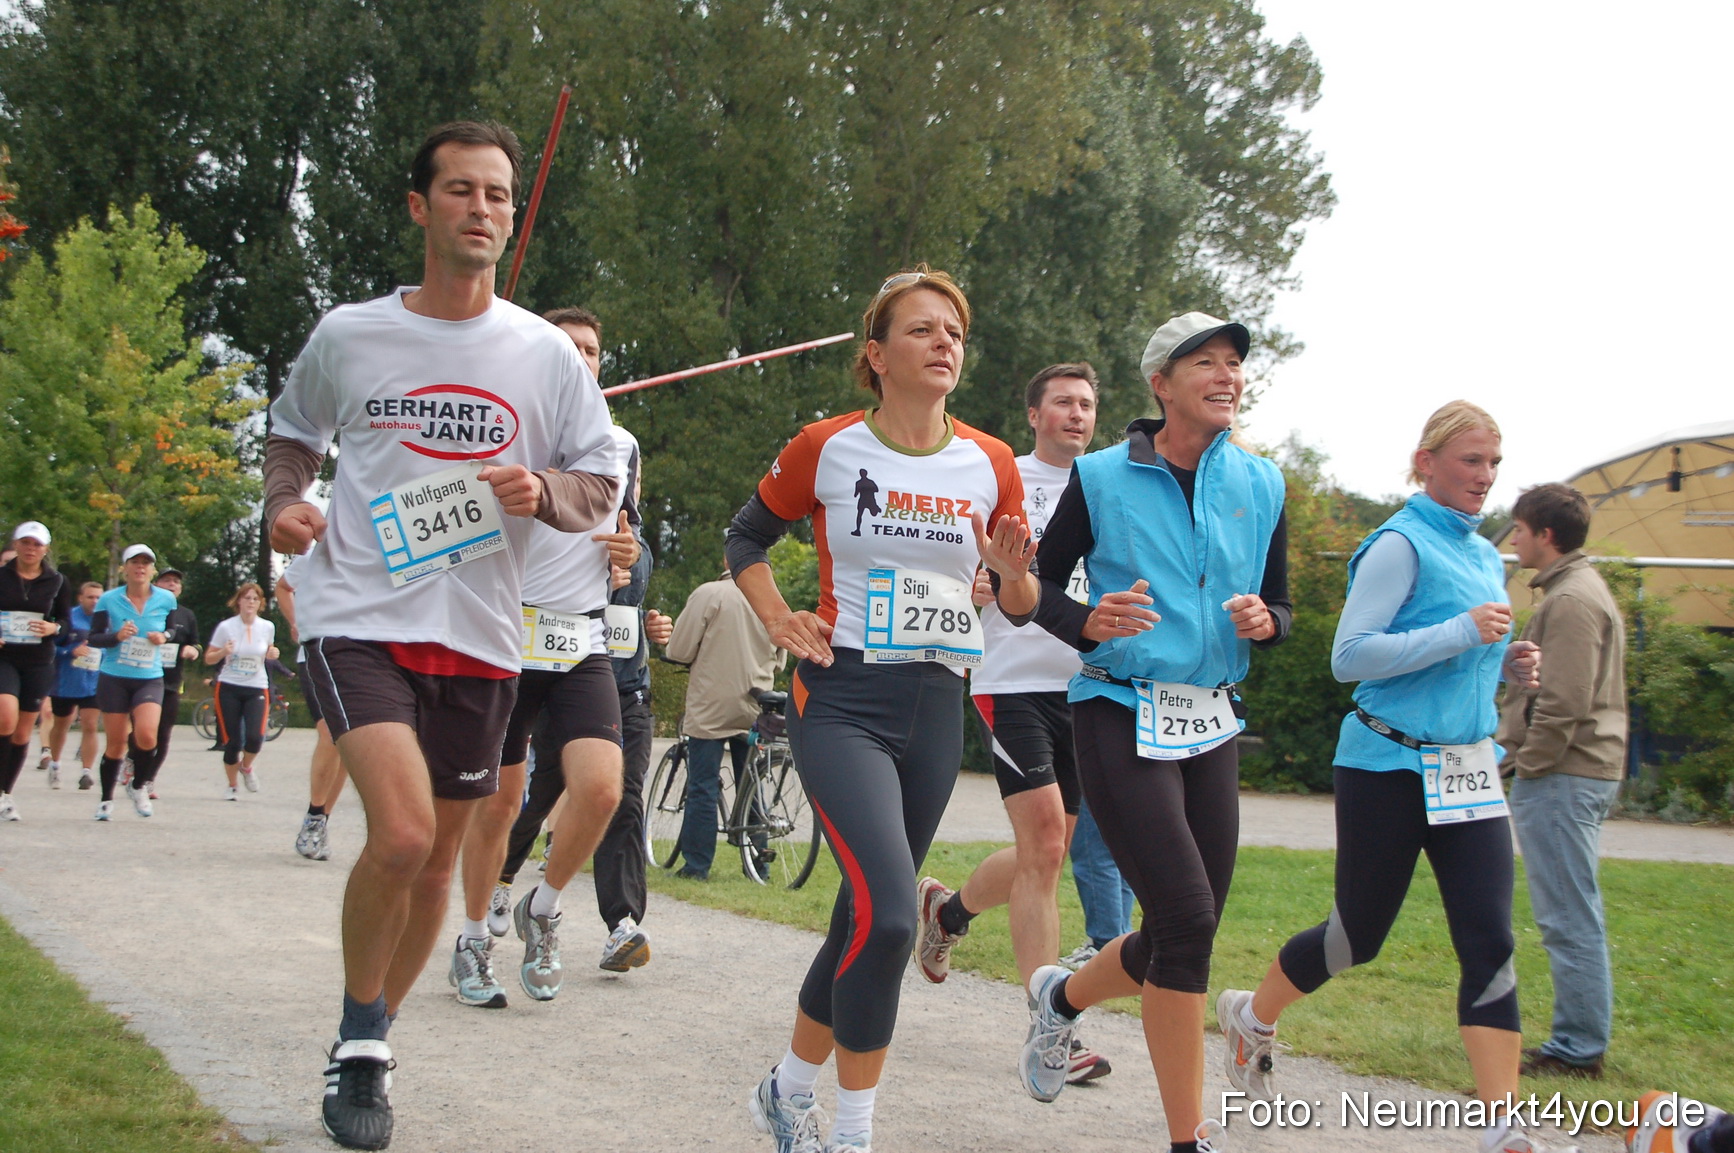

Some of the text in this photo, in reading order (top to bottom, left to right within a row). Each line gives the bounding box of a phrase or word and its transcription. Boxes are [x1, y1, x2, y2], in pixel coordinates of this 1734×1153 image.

[366, 399, 504, 424] GERHART &
[370, 420, 422, 431] Autohaus
[421, 421, 505, 444] JÄNIG
[400, 479, 467, 509] Wolfgang
[887, 490, 974, 519] MERZ
[413, 499, 483, 542] 3416
[882, 503, 956, 527] Reisen
[383, 527, 393, 540] C
[872, 524, 964, 545] TEAM 2008
[460, 535, 504, 558] PFLEIDERER
[903, 577, 929, 599] Sigi
[875, 603, 883, 616] C
[538, 614, 576, 631] Andreas
[903, 606, 972, 635] 2789
[544, 633, 579, 653] 825
[937, 649, 982, 665] PFLEIDERER
[1159, 690, 1193, 709] Petra
[1143, 707, 1149, 718] C
[1162, 715, 1222, 736] 2781
[1445, 752, 1462, 766] Pia
[459, 768, 489, 781] JAKO
[1444, 770, 1491, 794] 2782
